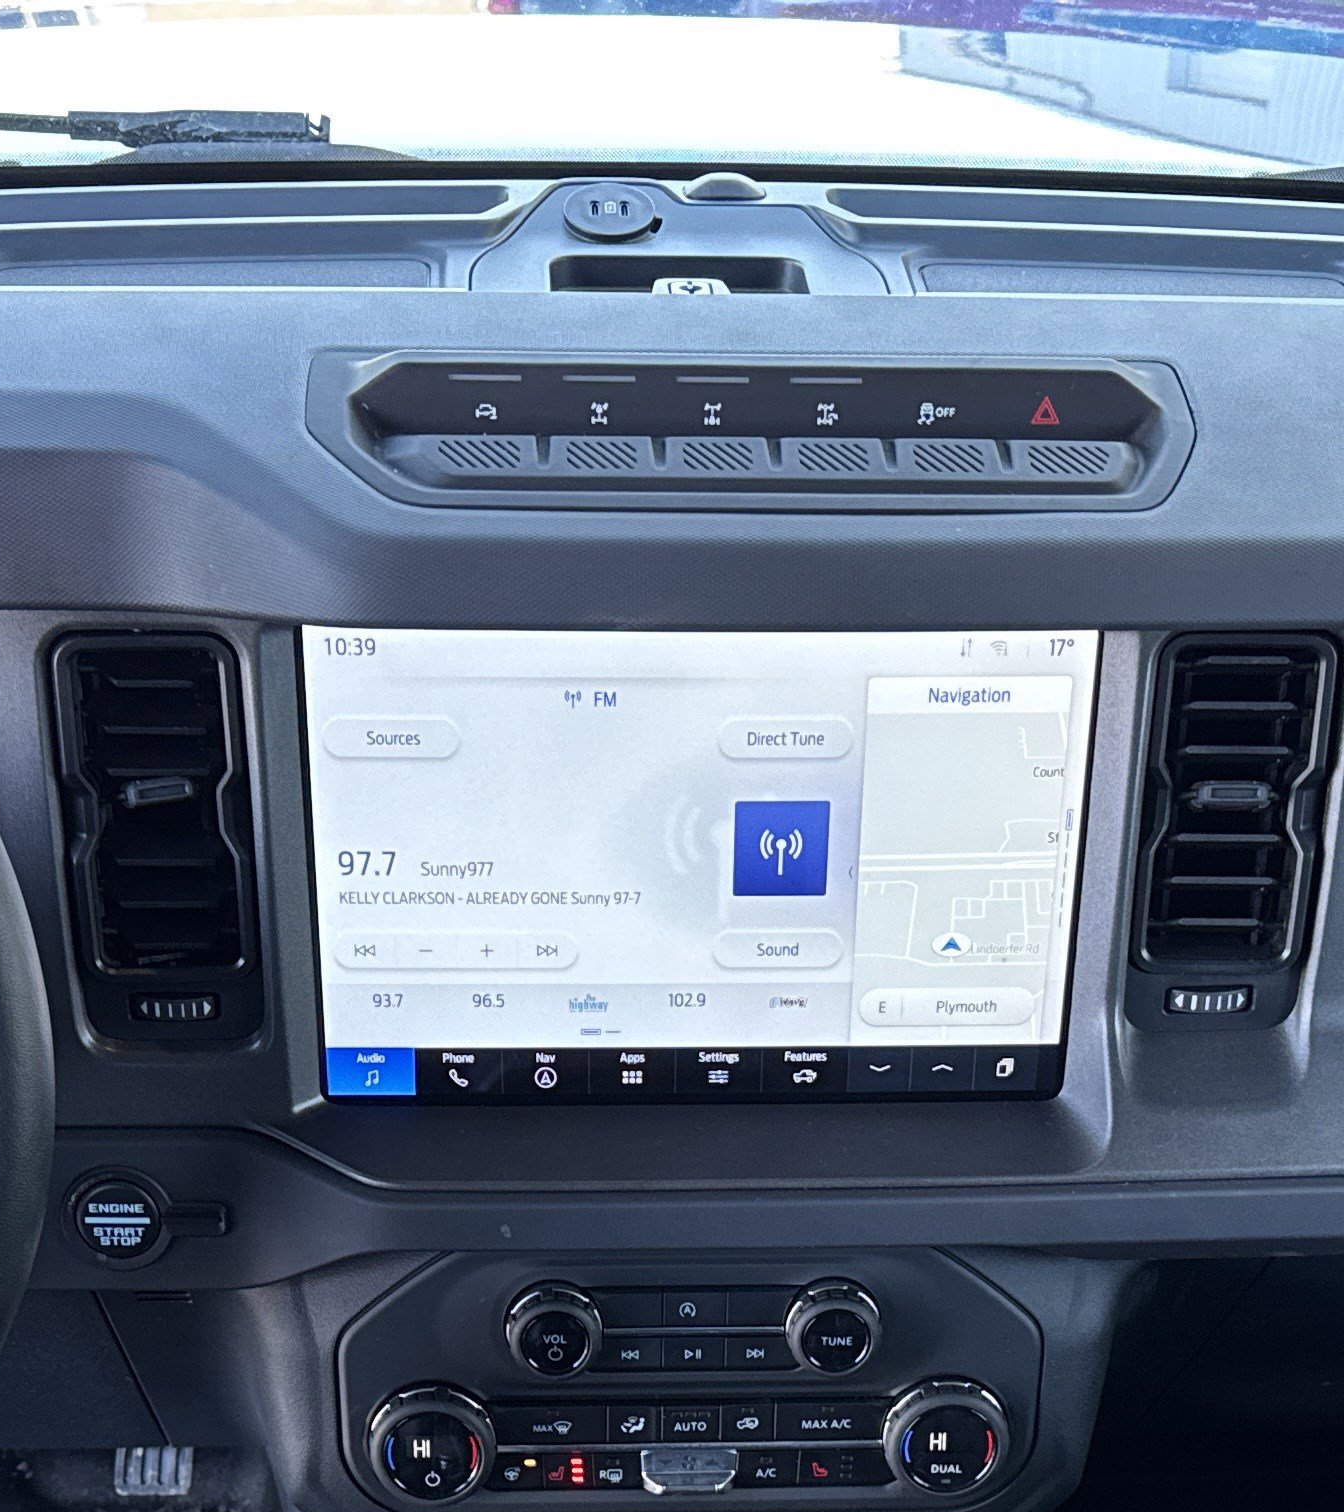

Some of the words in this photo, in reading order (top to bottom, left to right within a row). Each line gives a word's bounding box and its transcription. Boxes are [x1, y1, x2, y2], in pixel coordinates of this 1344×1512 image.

[935, 406, 956, 418] OFF
[323, 637, 376, 656] 10:39
[1049, 638, 1075, 657] 17°
[594, 692, 617, 707] FM
[928, 687, 1011, 706] Navigation
[366, 730, 421, 746] Sources
[747, 731, 787, 747] Direct
[790, 731, 825, 747] Tune
[338, 850, 396, 876] 97.7
[420, 861, 494, 879] Sunny977
[339, 891, 379, 906] KELLY
[382, 891, 455, 906] CLARKSON
[466, 891, 528, 906] ALREADY
[530, 891, 568, 906] GONE
[570, 891, 610, 908] Sunny
[614, 891, 642, 906] 97-7
[756, 942, 799, 958] Sound
[372, 993, 403, 1008] 93.7
[472, 993, 505, 1008] 96.5
[668, 993, 706, 1008] 102.9
[878, 1001, 887, 1014] E
[935, 1000, 998, 1016] Plymouth
[356, 1052, 386, 1064] Audio
[442, 1052, 475, 1064] Phone
[535, 1052, 556, 1064] Nav
[620, 1052, 646, 1066] Apps
[698, 1051, 740, 1065] Settings
[784, 1050, 827, 1063] Features
[88, 1203, 144, 1214] ENGINE
[93, 1227, 145, 1237] START
[100, 1236, 141, 1246] STOP
[542, 1334, 568, 1345] VOL
[821, 1336, 853, 1347] TUNE
[532, 1424, 554, 1433] MAX
[674, 1421, 707, 1432] AUTO
[801, 1420, 828, 1429] MAX
[830, 1419, 852, 1429] A/C
[413, 1439, 430, 1458] HI
[929, 1432, 947, 1451] HI
[756, 1468, 776, 1478] A/C
[930, 1464, 962, 1474] DUAL
